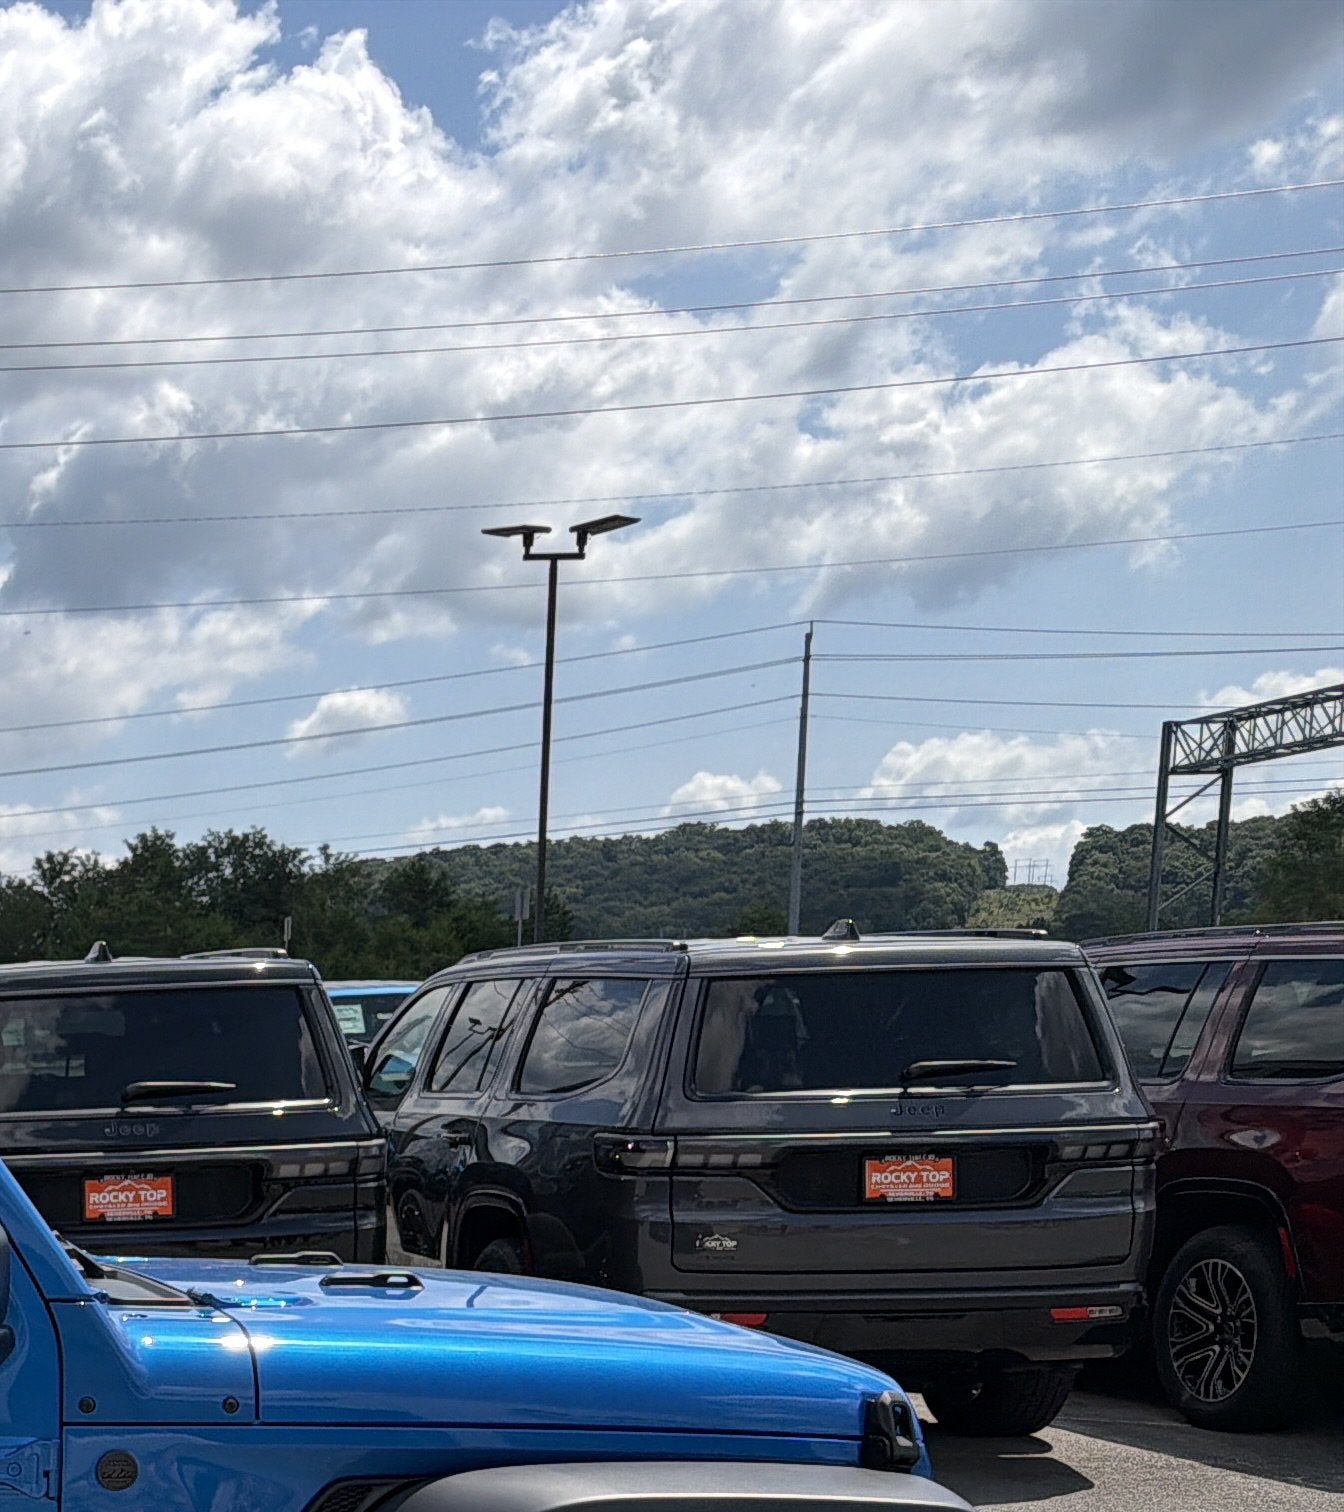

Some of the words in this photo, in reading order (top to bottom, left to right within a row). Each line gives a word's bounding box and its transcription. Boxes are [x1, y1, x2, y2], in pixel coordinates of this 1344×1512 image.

[890, 1102, 945, 1118] Jeep
[104, 1121, 160, 1138] Jeep
[872, 1172, 917, 1183] ROCKY
[921, 1171, 949, 1182] TOP
[90, 1191, 136, 1203] ROCKY
[139, 1190, 166, 1200] TOP
